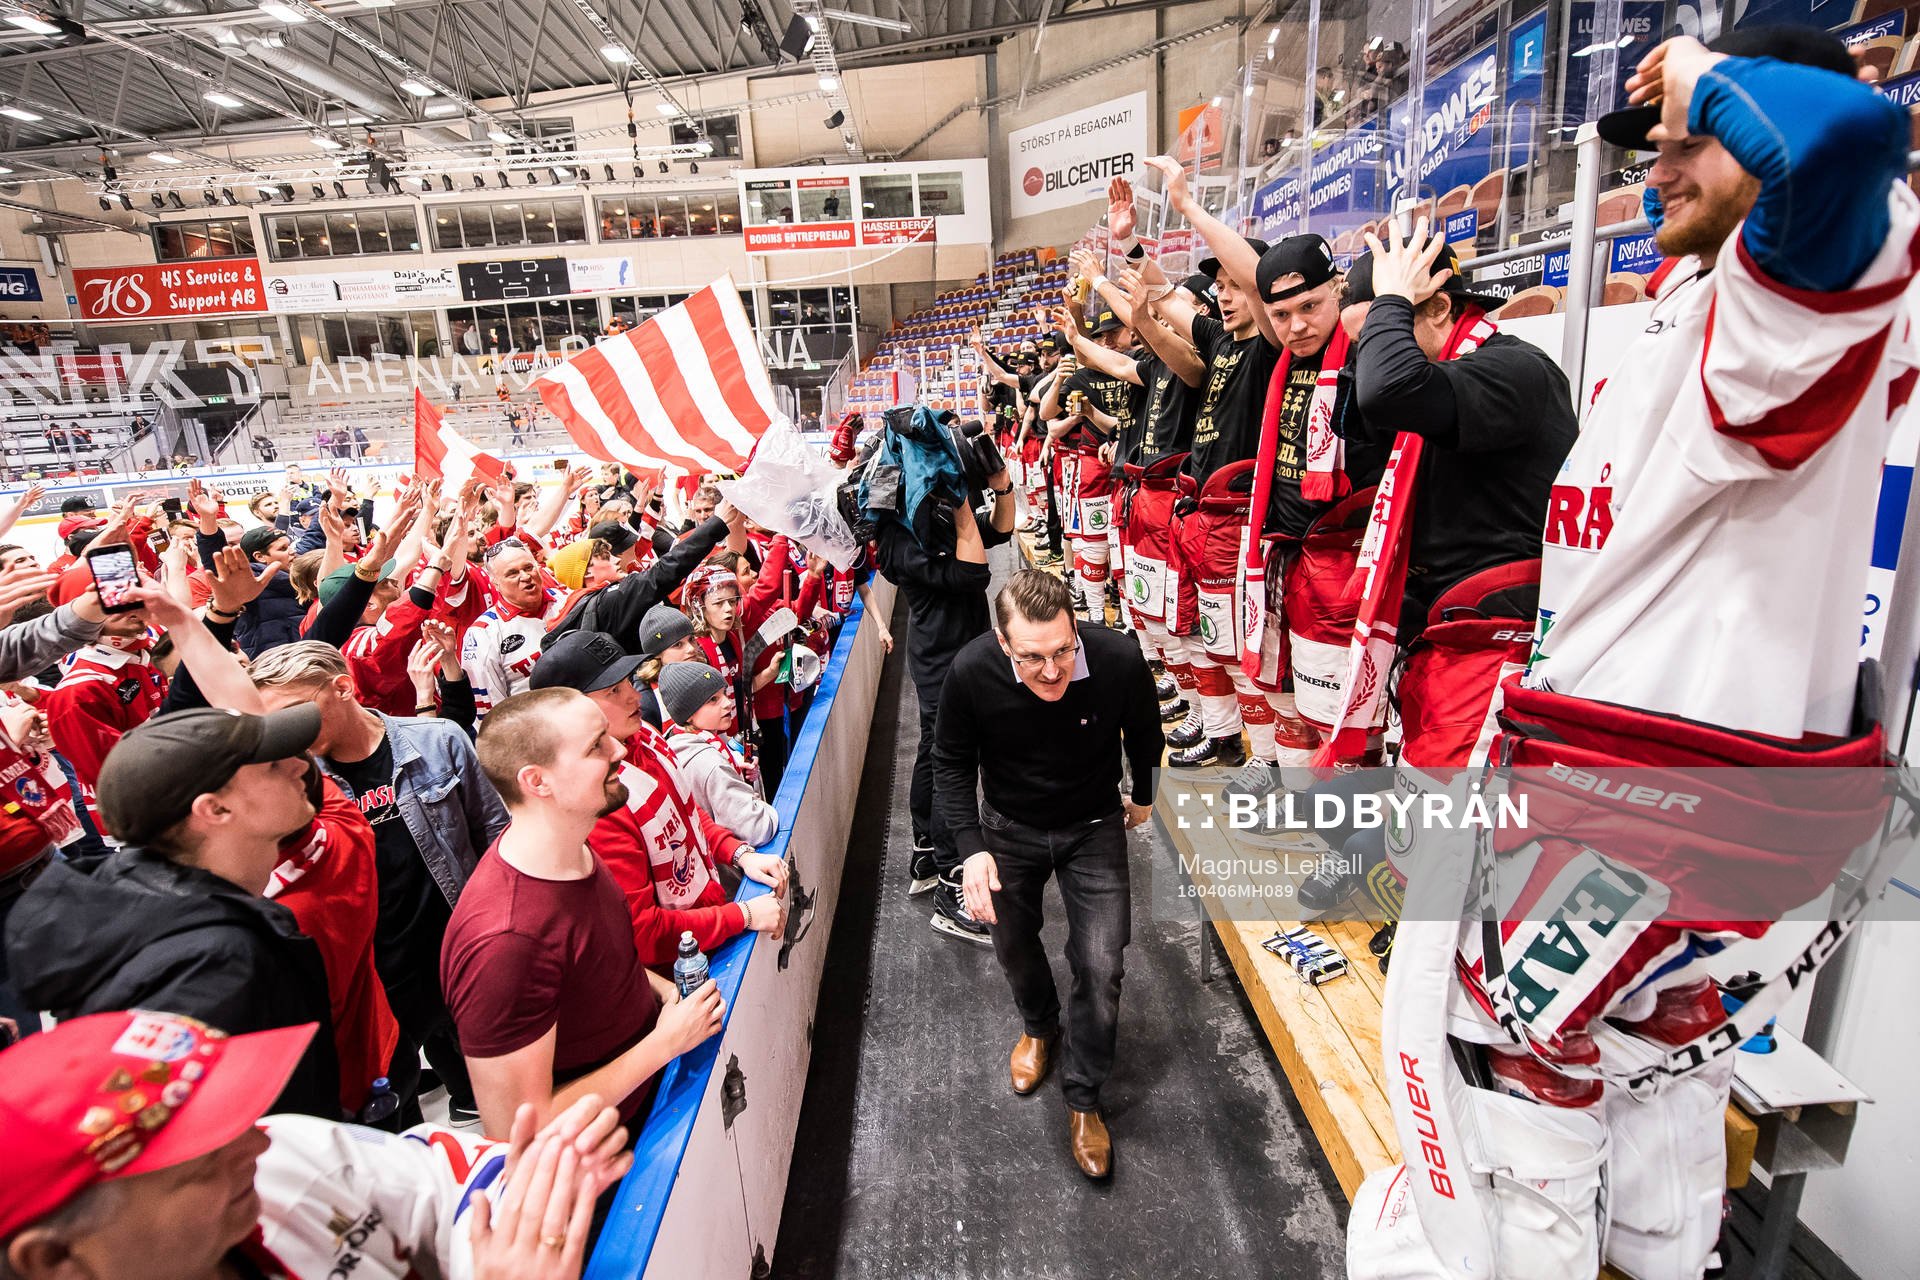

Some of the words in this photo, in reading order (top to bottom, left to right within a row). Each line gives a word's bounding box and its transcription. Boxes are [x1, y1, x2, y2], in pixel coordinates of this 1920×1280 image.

[1020, 131, 1056, 152] STÖRST
[1058, 123, 1072, 142] PÅ
[1074, 109, 1133, 137] BEGAGNAT!
[1045, 152, 1135, 193] BILCENTER
[1311, 131, 1378, 185] AVKOPPLING!
[785, 229, 851, 243] ENTREPRENAD
[83, 273, 152, 316] HS
[160, 270, 181, 289] HS
[187, 268, 239, 287] Service
[244, 266, 256, 282] &
[394, 270, 425, 279] Daja's
[418, 277, 441, 285] GYM
[169, 293, 226, 312] Support
[230, 289, 256, 308] AB
[307, 351, 480, 398] ARENA
[463, 652, 478, 661] SCA
[1544, 760, 1703, 815] BAUER
[1399, 1051, 1456, 1201] BAUER
